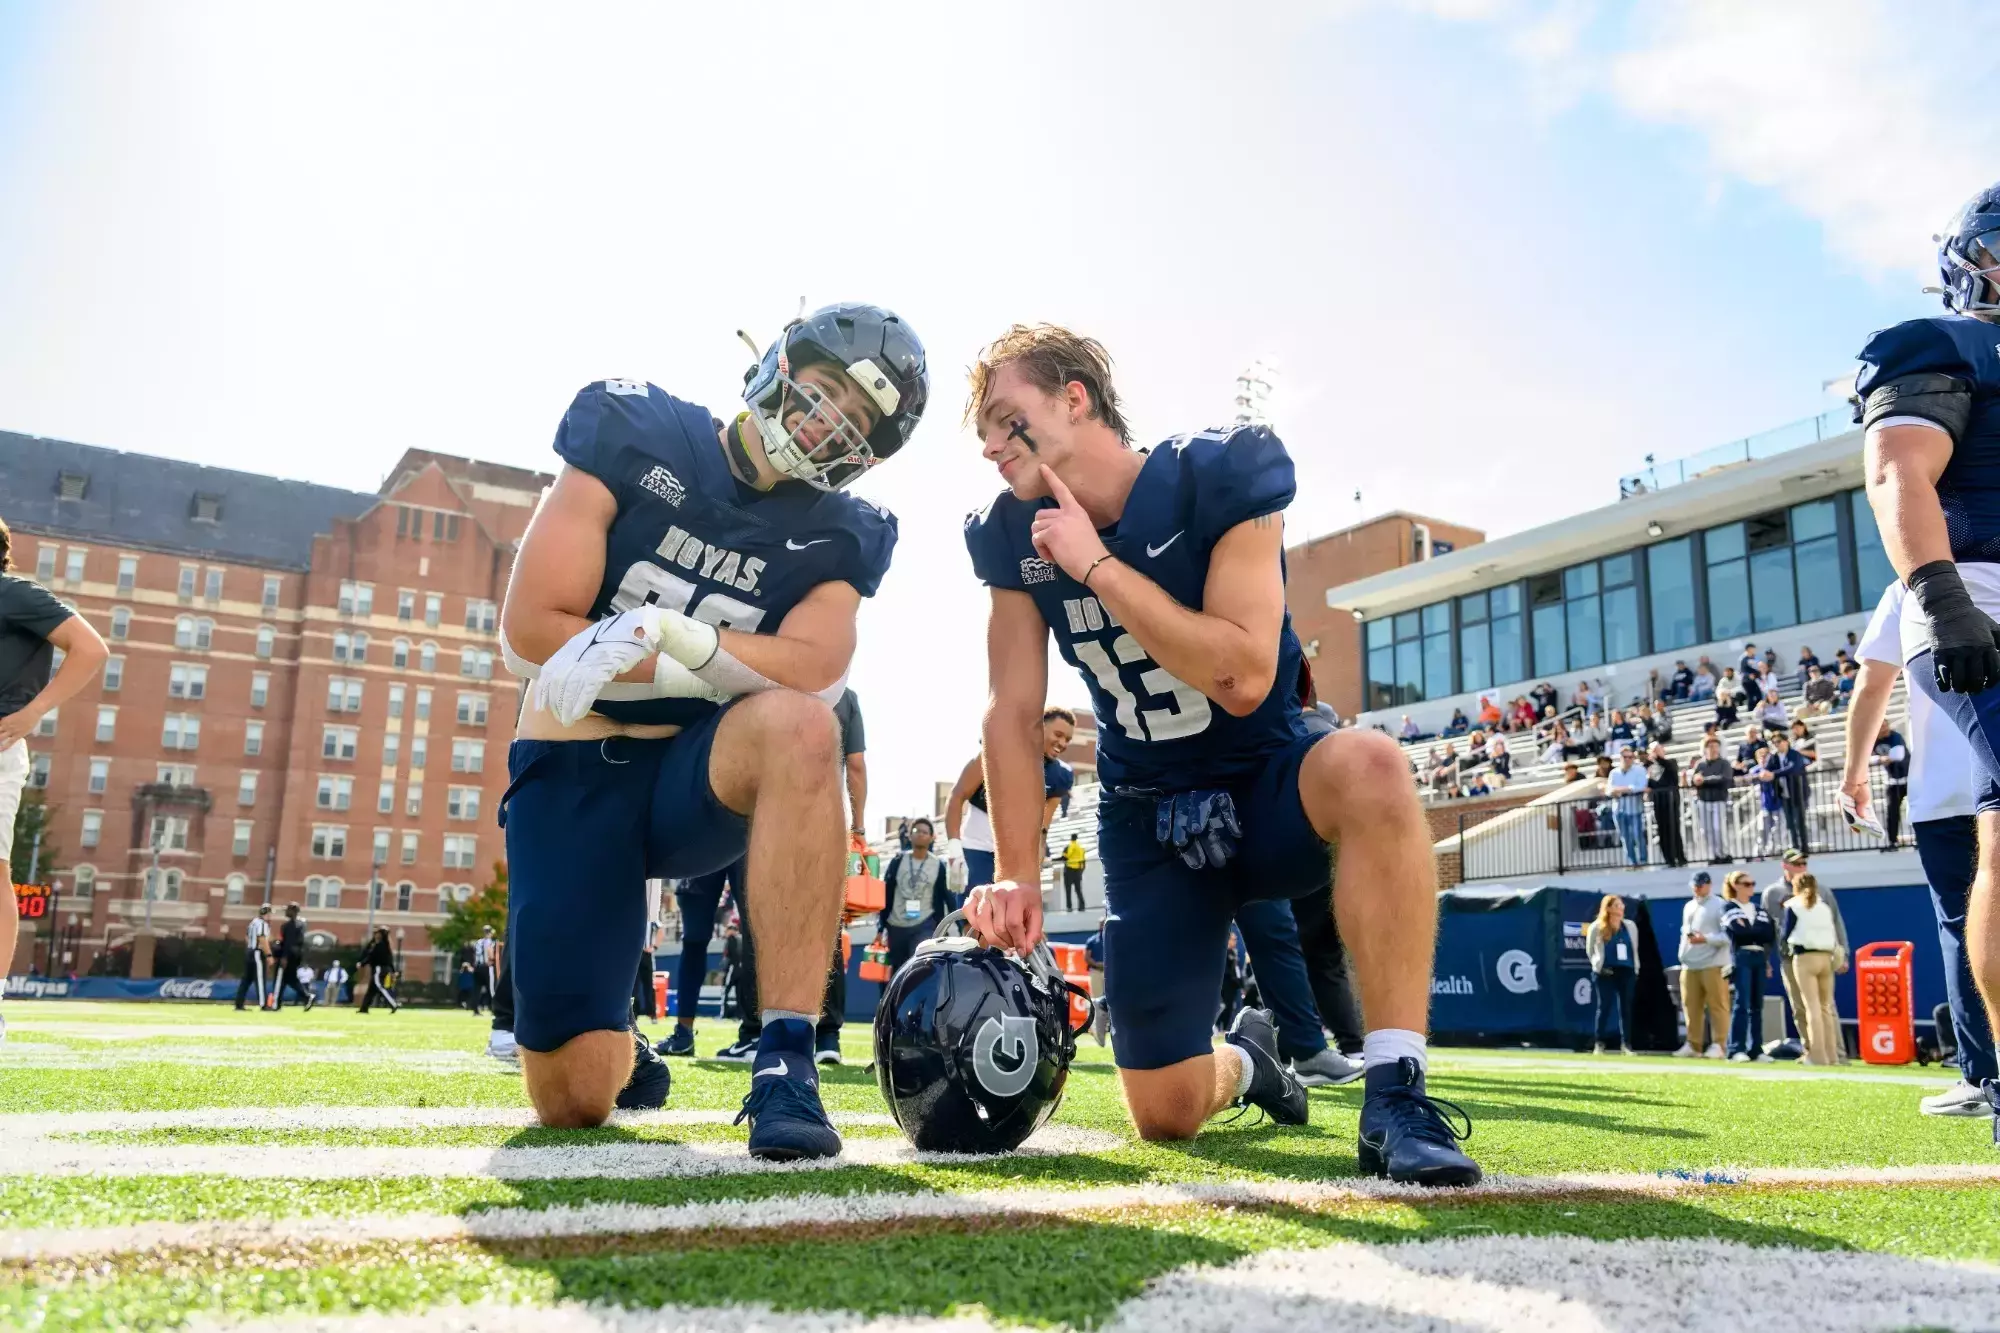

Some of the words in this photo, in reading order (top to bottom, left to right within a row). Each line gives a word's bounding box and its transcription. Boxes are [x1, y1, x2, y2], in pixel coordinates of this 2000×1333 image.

[639, 479, 681, 509] LEAGUE
[642, 473, 686, 502] PATRIOT
[655, 525, 767, 592] HOYAS
[1020, 567, 1054, 580] PATRIOT
[1023, 574, 1056, 585] LEAGUE
[1072, 633, 1212, 742] 13
[1496, 949, 1540, 994] G
[973, 1011, 1039, 1097] G
[1872, 1031, 1895, 1055] G
